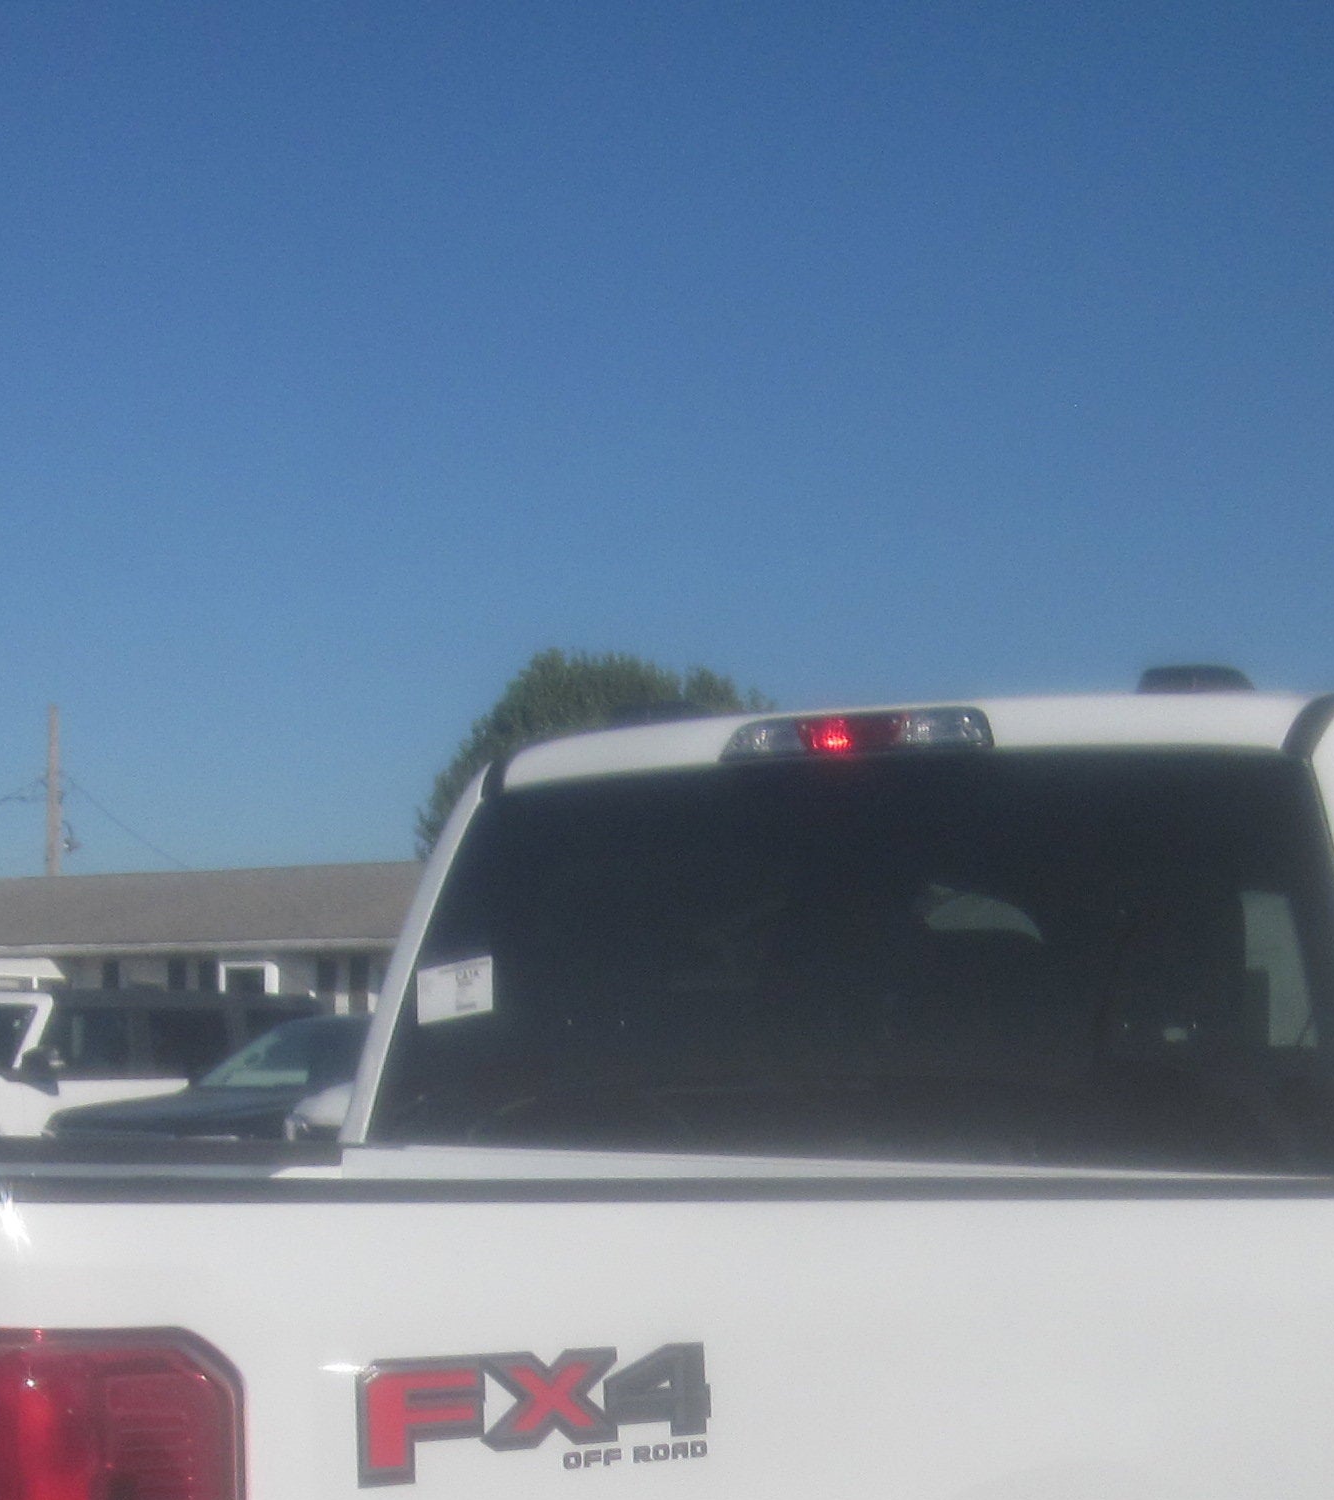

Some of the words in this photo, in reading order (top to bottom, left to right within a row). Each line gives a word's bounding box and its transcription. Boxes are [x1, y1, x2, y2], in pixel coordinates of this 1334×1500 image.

[356, 1341, 711, 1488] FX4
[562, 1449, 623, 1470] OFF
[633, 1440, 708, 1463] ROAD
